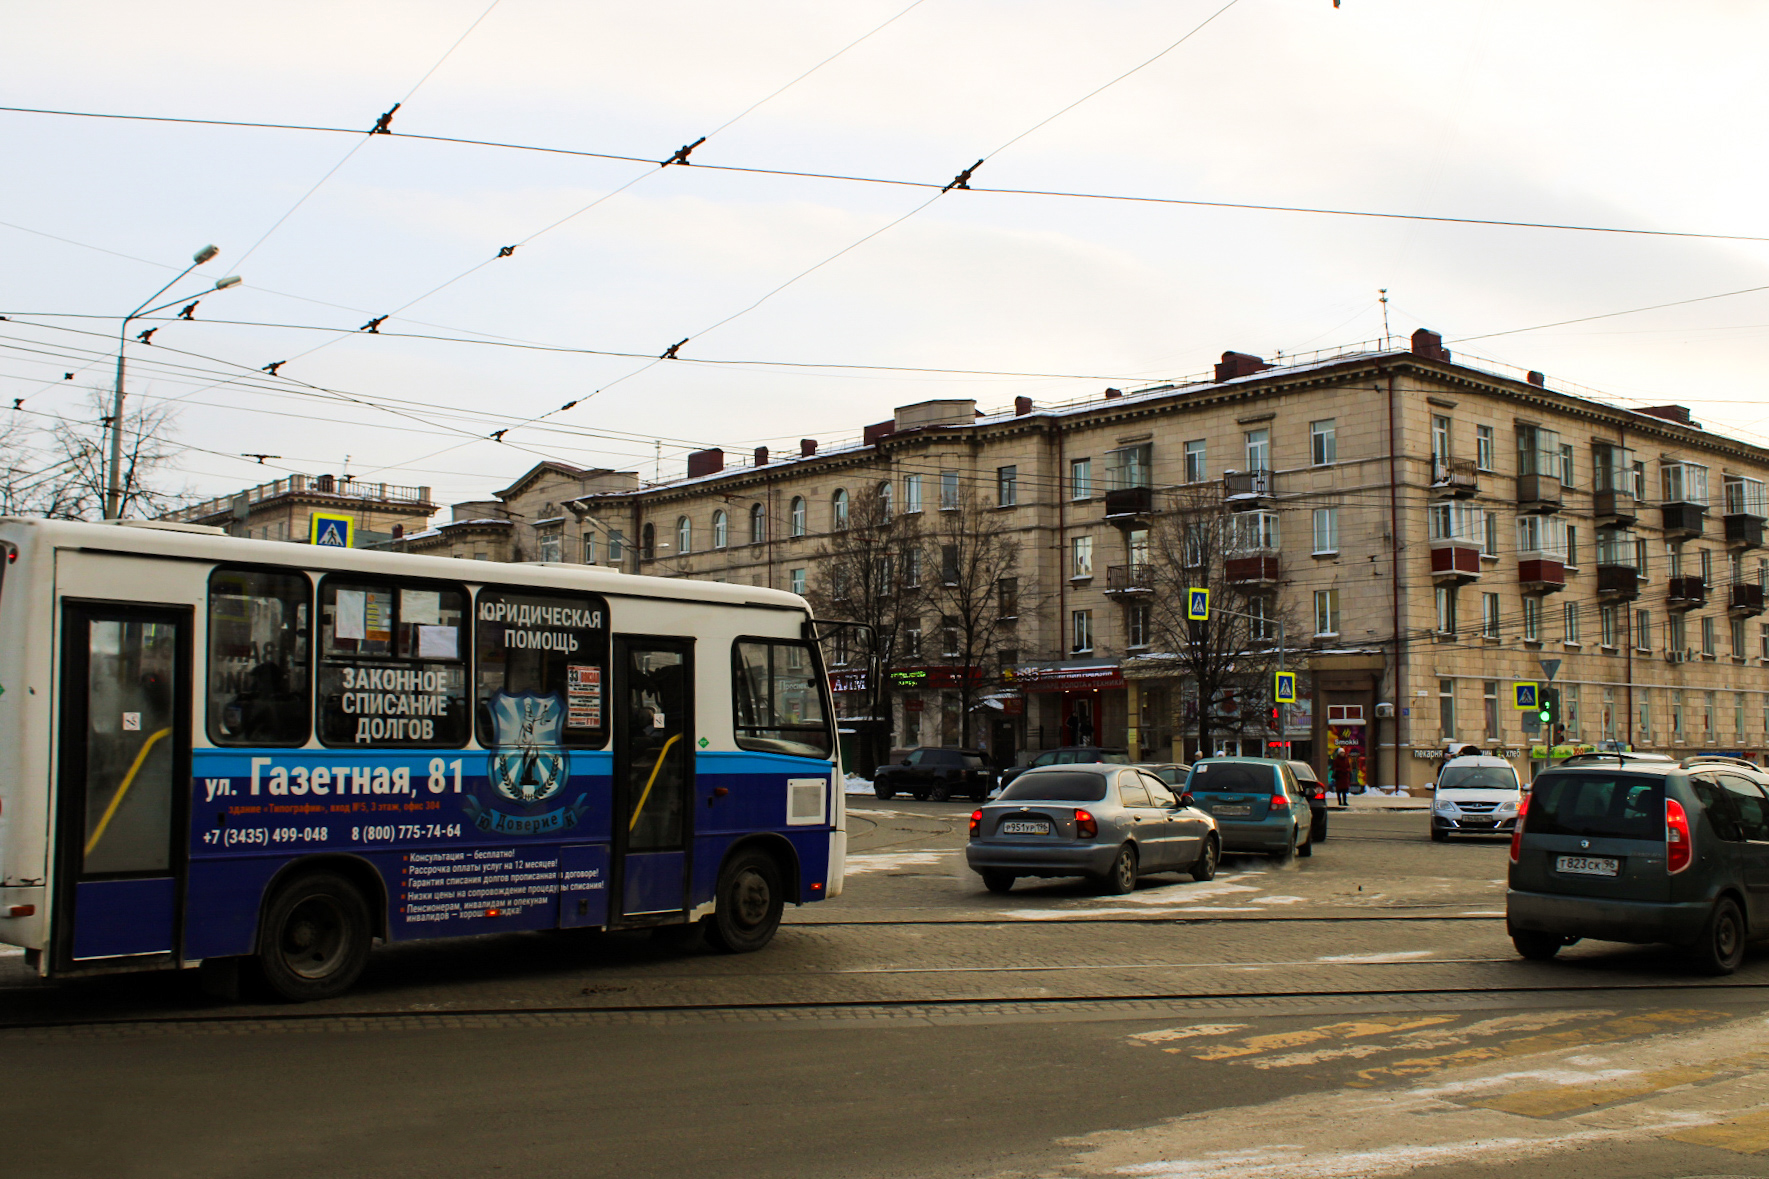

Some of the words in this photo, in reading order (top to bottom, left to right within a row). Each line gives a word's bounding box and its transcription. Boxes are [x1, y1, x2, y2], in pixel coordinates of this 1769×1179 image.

[480, 602, 601, 628] ЮРИДИЧЕСКАЯ
[505, 629, 579, 655] ПОМОЩЬ
[342, 667, 448, 692] ЗАКОННОЕ
[342, 692, 448, 716] СПИСАНИЕ
[355, 718, 435, 744] ДОЛГОВ
[1414, 749, 1443, 759] пекарня
[1505, 748, 1521, 757] хлеб
[205, 778, 238, 802] ул.
[250, 757, 417, 799] Газетная,
[428, 757, 462, 793] 81
[371, 802, 377, 811] 3
[495, 813, 558, 834] Доверие
[203, 829, 221, 844] +7
[224, 827, 269, 847] (3435)
[272, 827, 328, 842] 499-048
[351, 827, 360, 840] 8
[363, 825, 396, 843] (800)
[398, 824, 461, 838] 775-74-64
[409, 852, 465, 863] Консультация
[473, 849, 515, 859] бесплатно!
[1602, 859, 1615, 868] 96
[409, 865, 451, 876] Рассрочка
[452, 864, 481, 873] оплаты
[482, 862, 502, 873] услуг
[504, 862, 513, 870] на
[515, 860, 524, 869] 12
[525, 858, 558, 869] месяцев!
[408, 878, 445, 889] Гарантия
[446, 876, 482, 886] списания
[483, 874, 510, 884] долгов
[510, 871, 557, 883] прописанная
[564, 868, 600, 879] договоре!
[407, 891, 433, 901] Низки
[433, 890, 456, 900] цены
[456, 890, 466, 898] на
[467, 886, 527, 898] сопровождение
[569, 880, 605, 891] списания!
[406, 902, 463, 914] Пенсионерам,
[463, 899, 506, 910] инвалидам
[507, 899, 513, 907] и
[513, 896, 548, 907] опекунам
[406, 911, 450, 922] инвалидов
